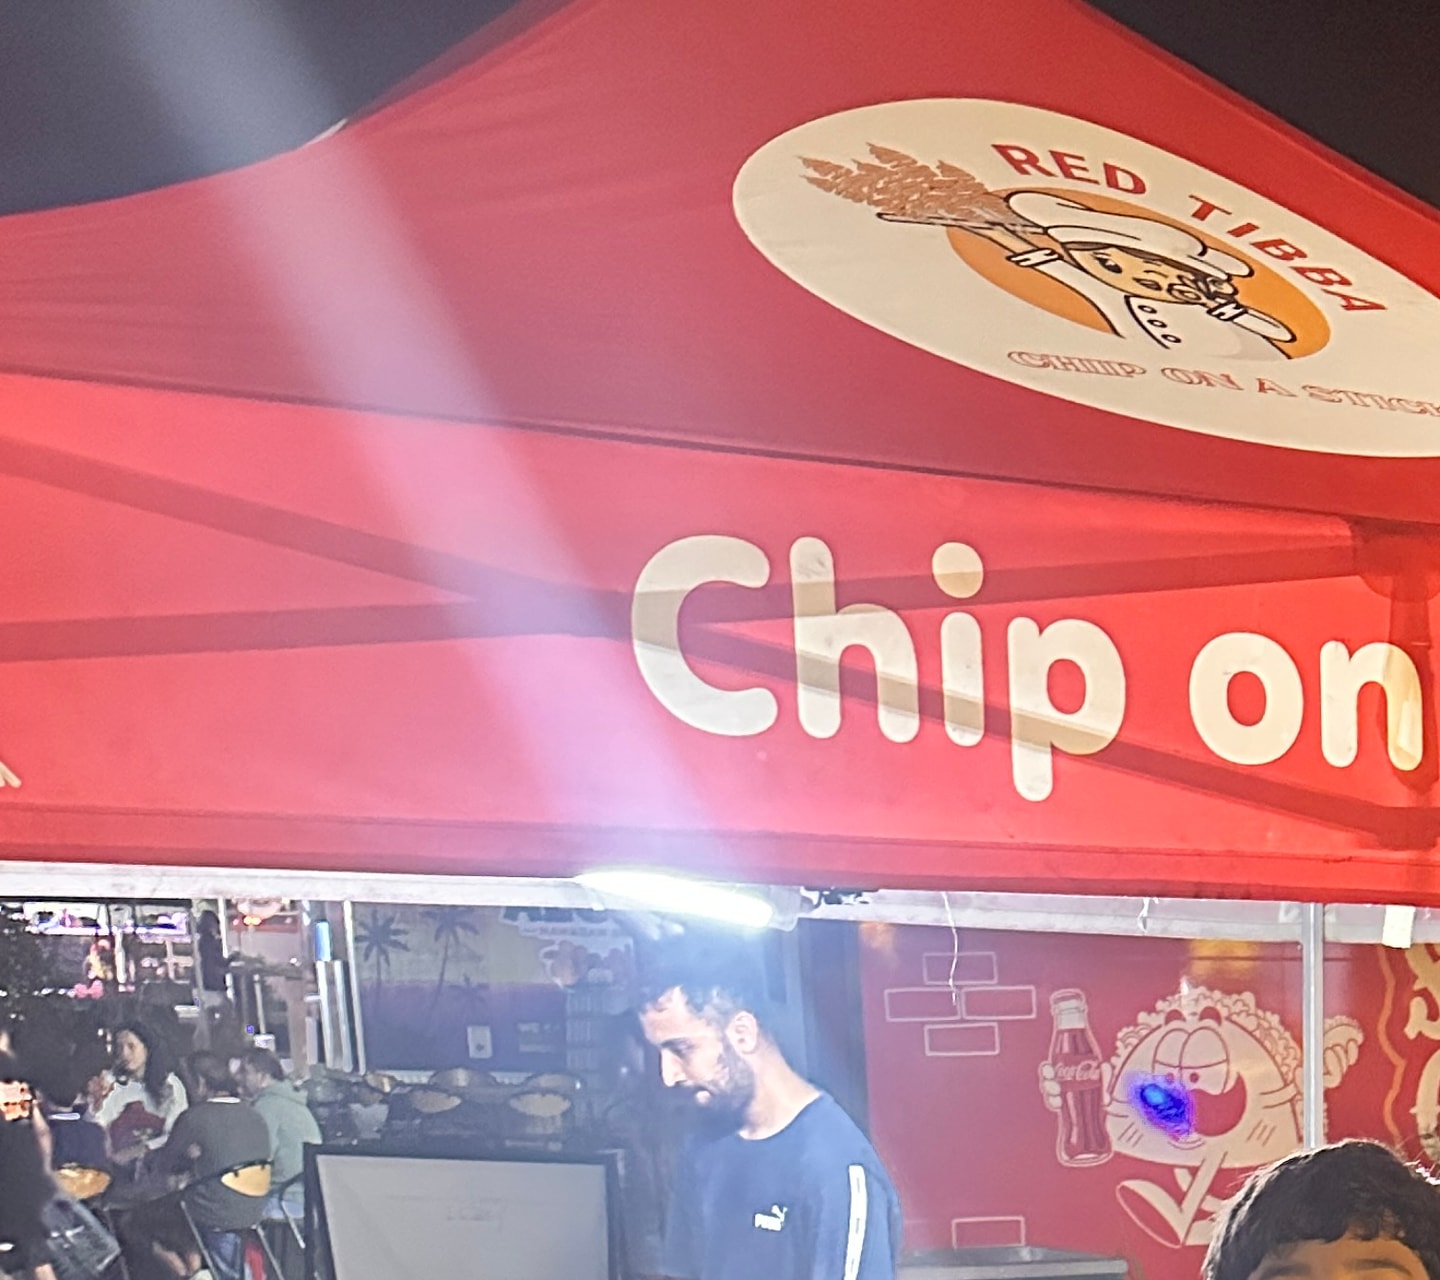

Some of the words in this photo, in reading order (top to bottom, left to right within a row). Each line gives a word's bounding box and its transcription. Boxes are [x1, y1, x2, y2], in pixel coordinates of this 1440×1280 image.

[991, 143, 1146, 196] RED
[1187, 194, 1389, 314] TIBBA
[1007, 350, 1147, 379] CHIP
[1160, 367, 1244, 392] ON
[1257, 376, 1298, 398] A
[630, 533, 1127, 803] Chip
[1188, 631, 1425, 771] on
